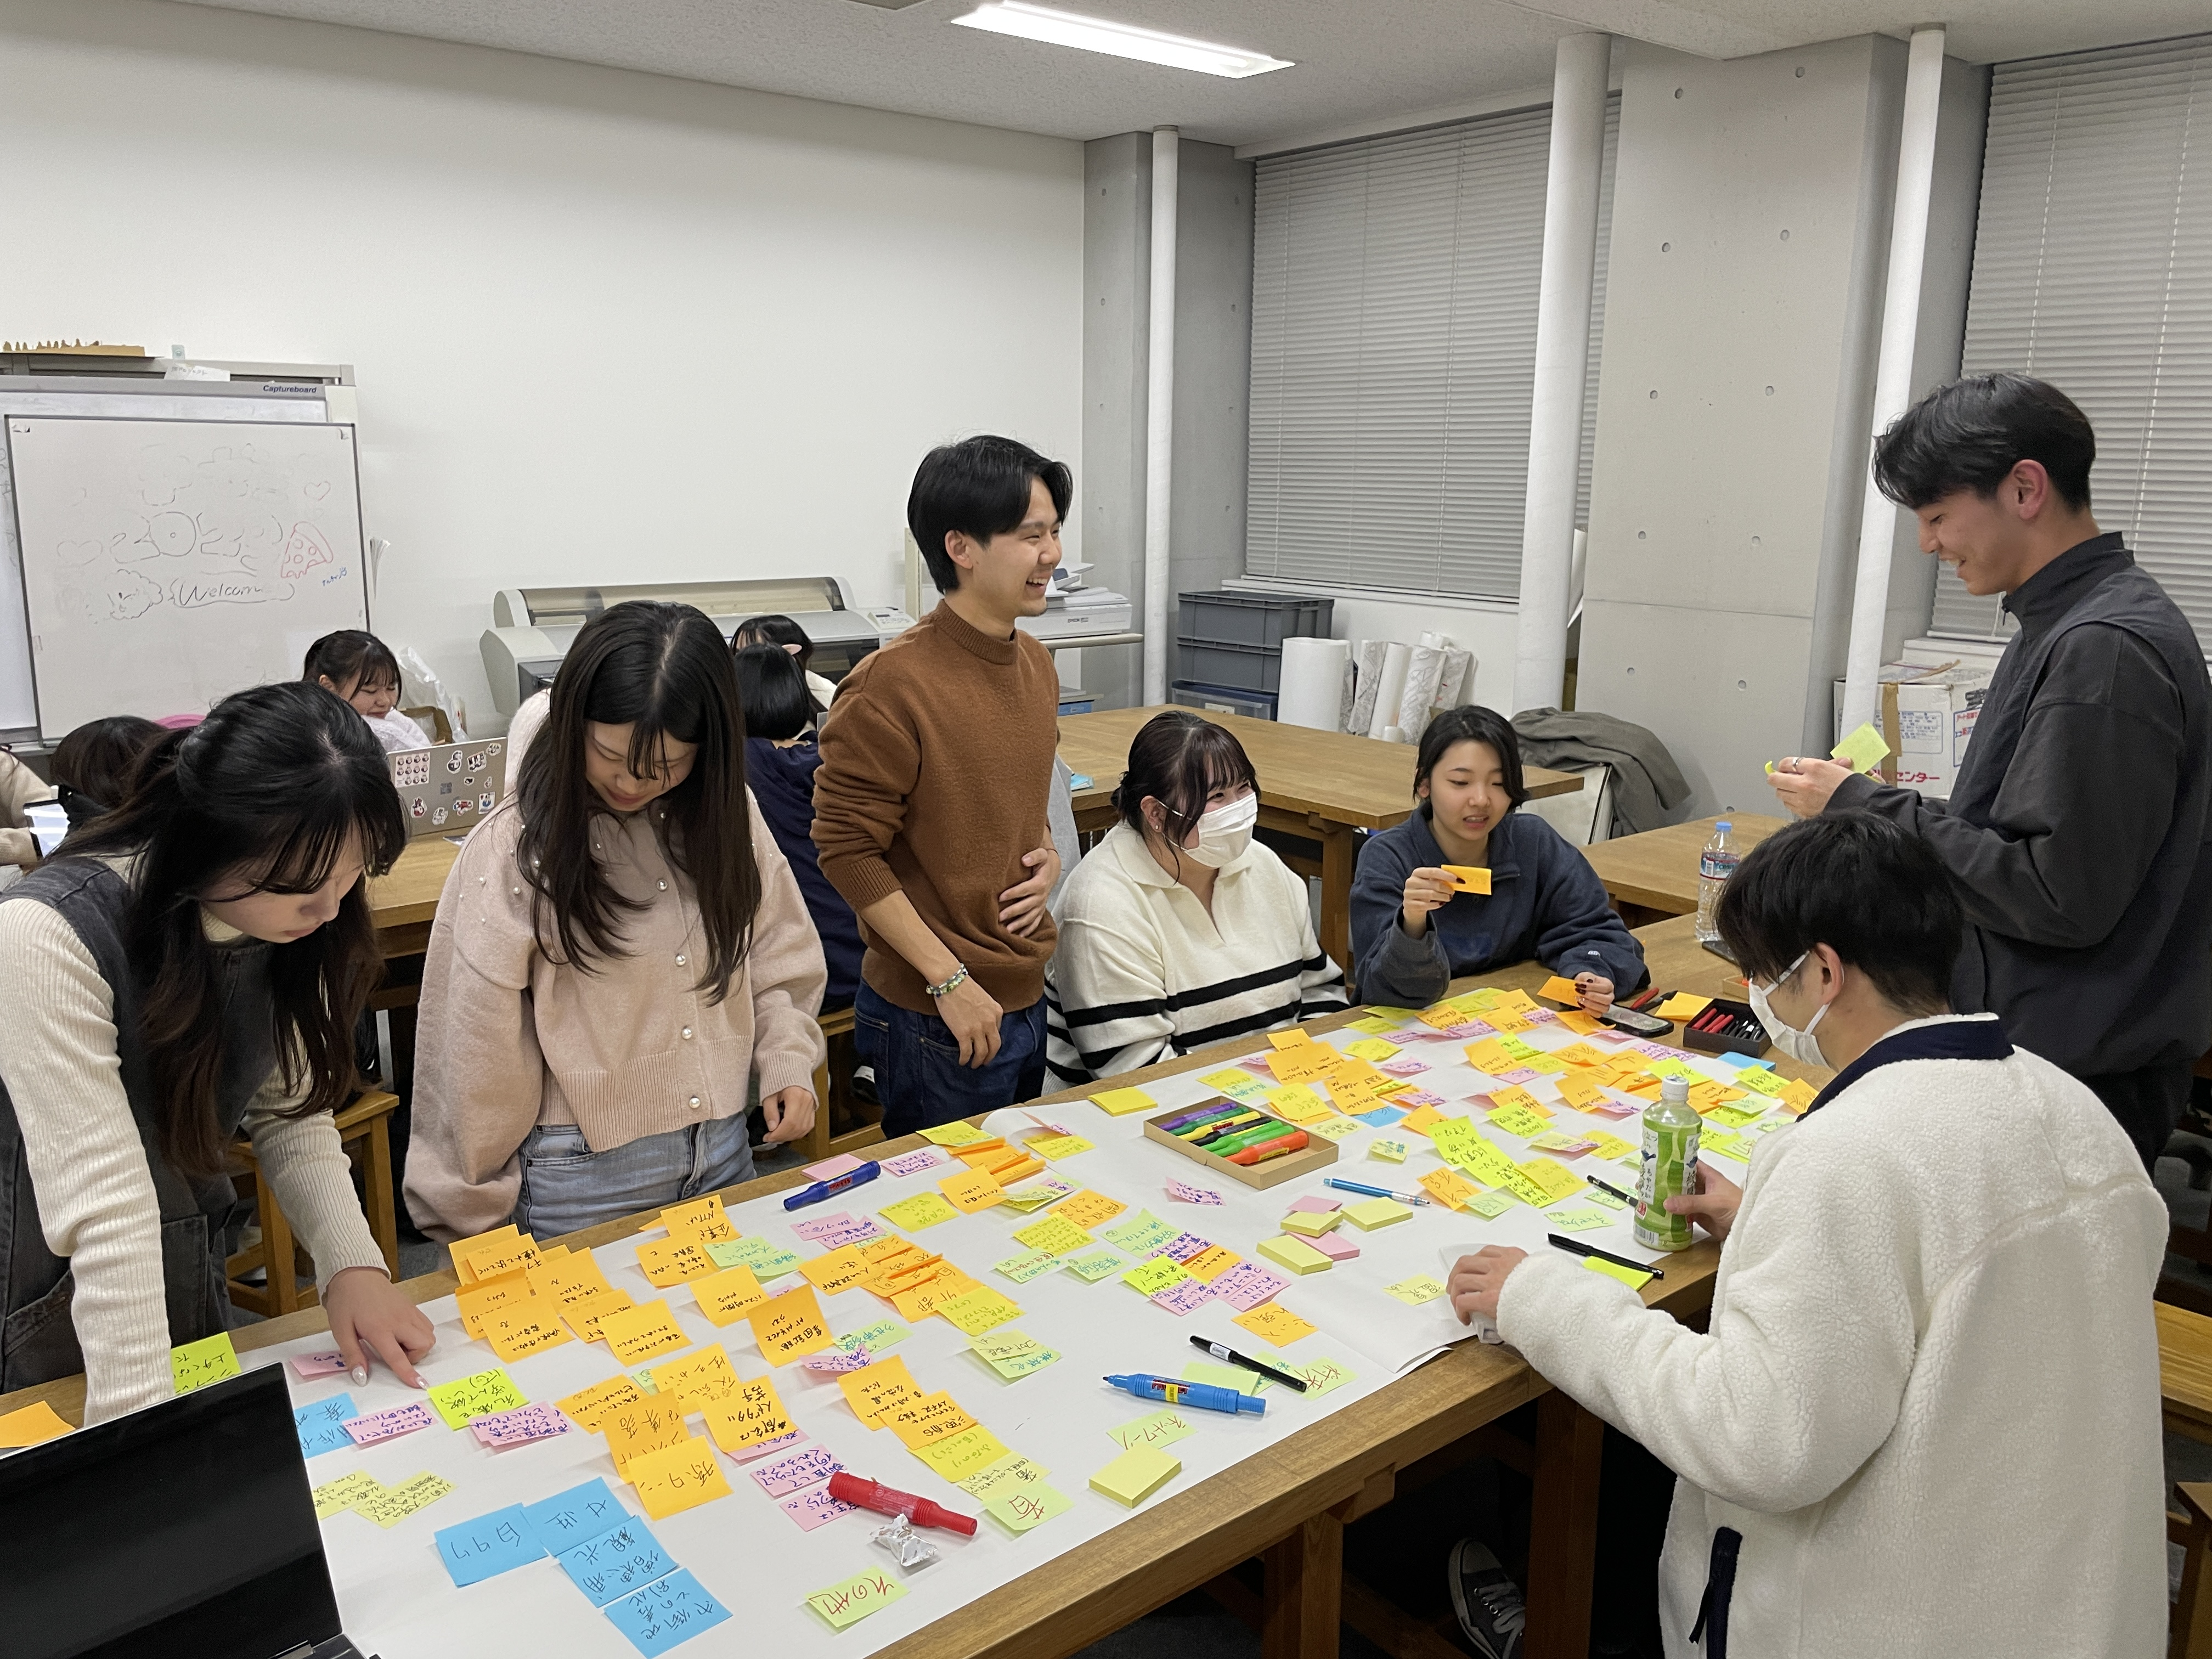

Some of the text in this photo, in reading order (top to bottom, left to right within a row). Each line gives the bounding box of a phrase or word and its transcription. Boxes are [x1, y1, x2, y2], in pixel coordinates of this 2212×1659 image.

[263, 385, 317, 393] Captureboard
[179, 583, 271, 606] Welcom
[718, 1292, 736, 1302] かかる
[1227, 1277, 1274, 1301] わってほしい
[719, 1295, 761, 1312] バスの時間が
[780, 1325, 821, 1351] 集団就職
[1009, 1351, 1053, 1370] 機械化
[445, 1384, 505, 1409] 学んで欲
[742, 1385, 766, 1402] 苦手
[861, 1381, 881, 1392] だった
[459, 1394, 514, 1418] 礼儀を
[619, 1409, 679, 1439] な集落
[923, 1416, 966, 1436] 漁船
[952, 1444, 991, 1468] ふなのり
[760, 1454, 831, 1490] 何をもたらして
[789, 1463, 844, 1488] 調査して
[545, 1500, 606, 1529] 女性
[1008, 1496, 1044, 1532] 昔
[570, 1527, 635, 1565] 観光
[583, 1550, 664, 1599] 増穂浦
[629, 1580, 669, 1606] 別化
[637, 1592, 689, 1622] との差
